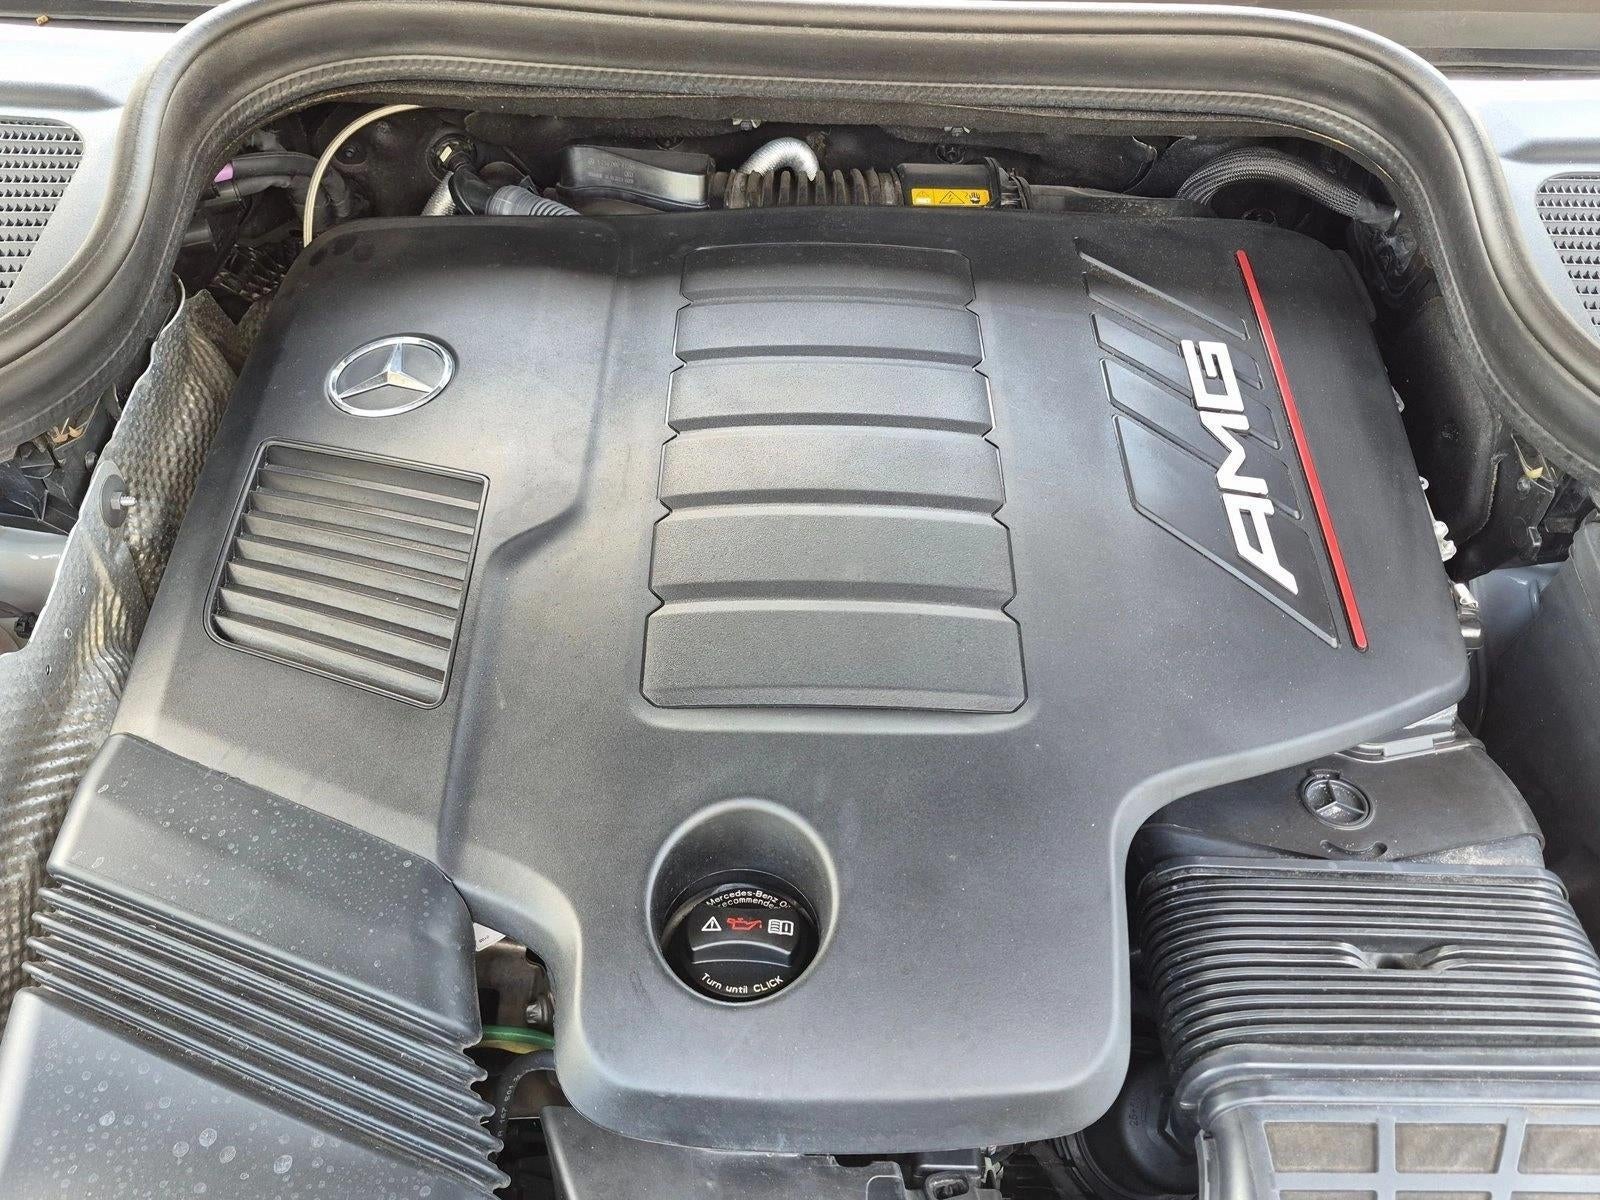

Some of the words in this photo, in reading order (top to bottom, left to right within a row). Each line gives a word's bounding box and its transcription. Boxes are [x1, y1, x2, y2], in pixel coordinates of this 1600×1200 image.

[1180, 339, 1299, 596] AMG
[706, 890, 778, 906] Mercedes-Benz
[717, 897, 781, 909] ecommende
[701, 972, 722, 990] Turn
[725, 985, 748, 994] until
[753, 975, 784, 993] CLICK
